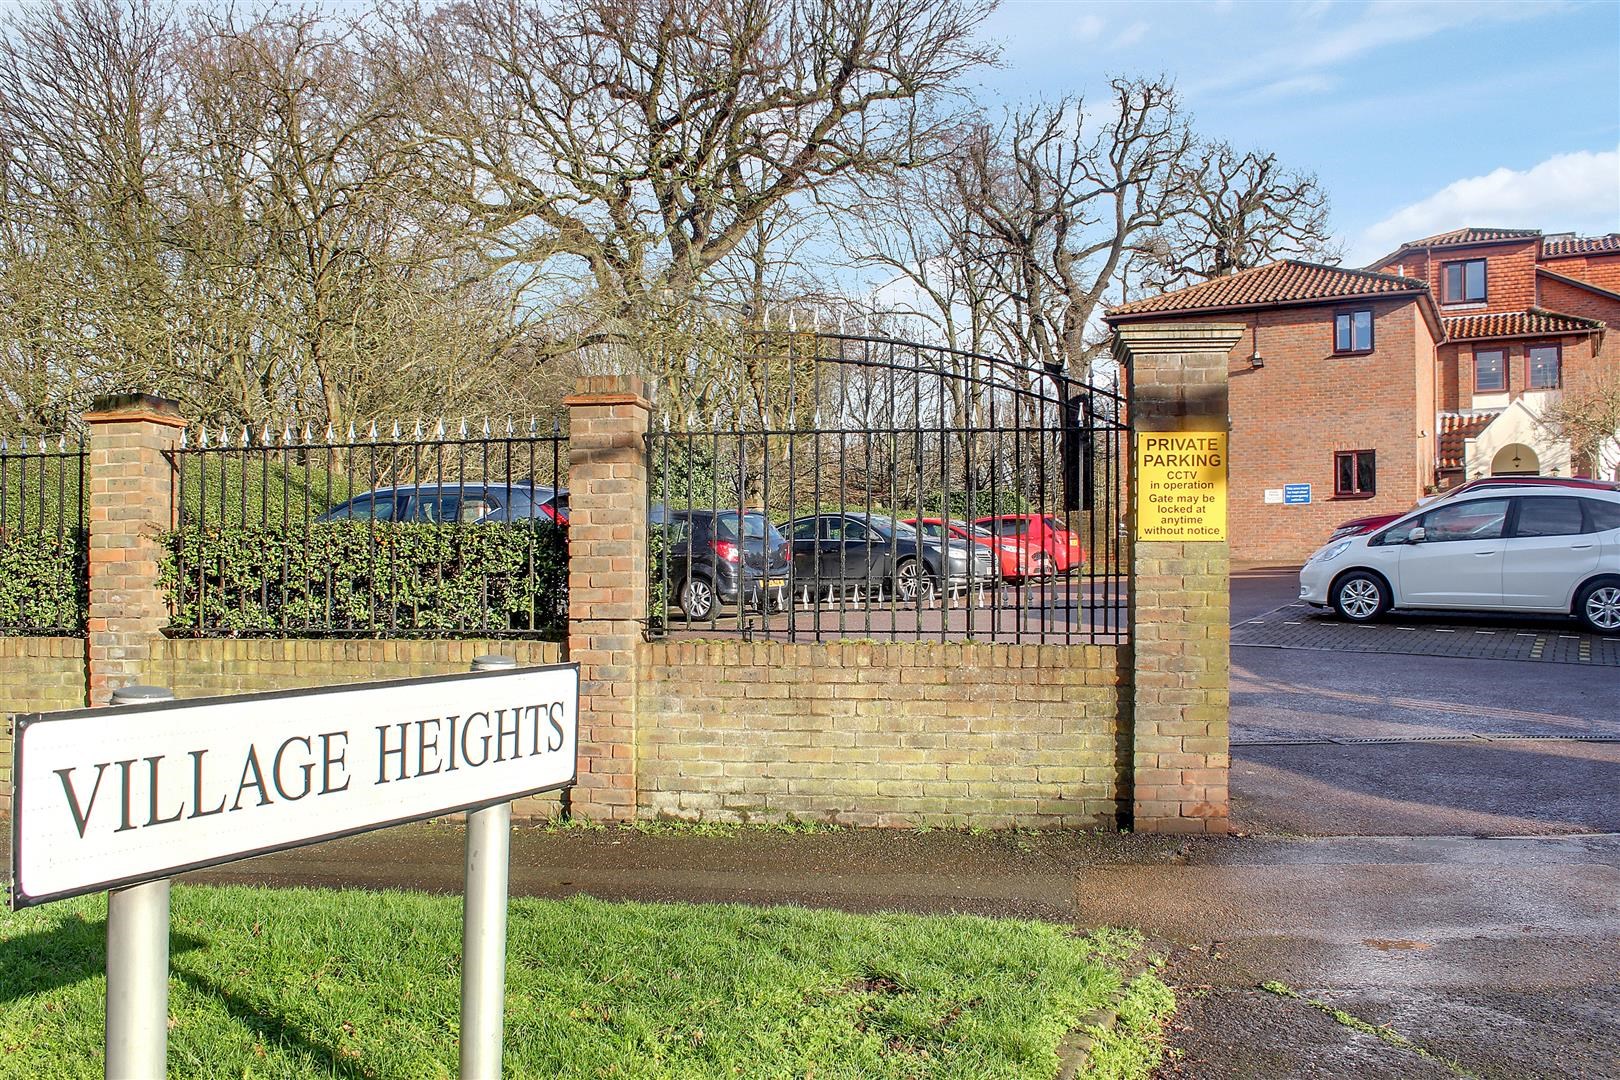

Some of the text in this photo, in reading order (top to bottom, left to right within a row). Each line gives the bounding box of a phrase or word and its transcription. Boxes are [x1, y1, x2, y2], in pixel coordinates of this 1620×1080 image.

[1147, 438, 1218, 451] PRIVATE
[1143, 454, 1221, 467] PARKING
[1167, 471, 1197, 480] CCTV
[1150, 481, 1214, 491] in operation
[1149, 494, 1215, 504] Gate may be
[1157, 505, 1206, 513] locked at
[1160, 515, 1203, 526] anytime
[1144, 526, 1220, 535] without notice
[53, 701, 565, 839] VILLAGE HEIGHTS
